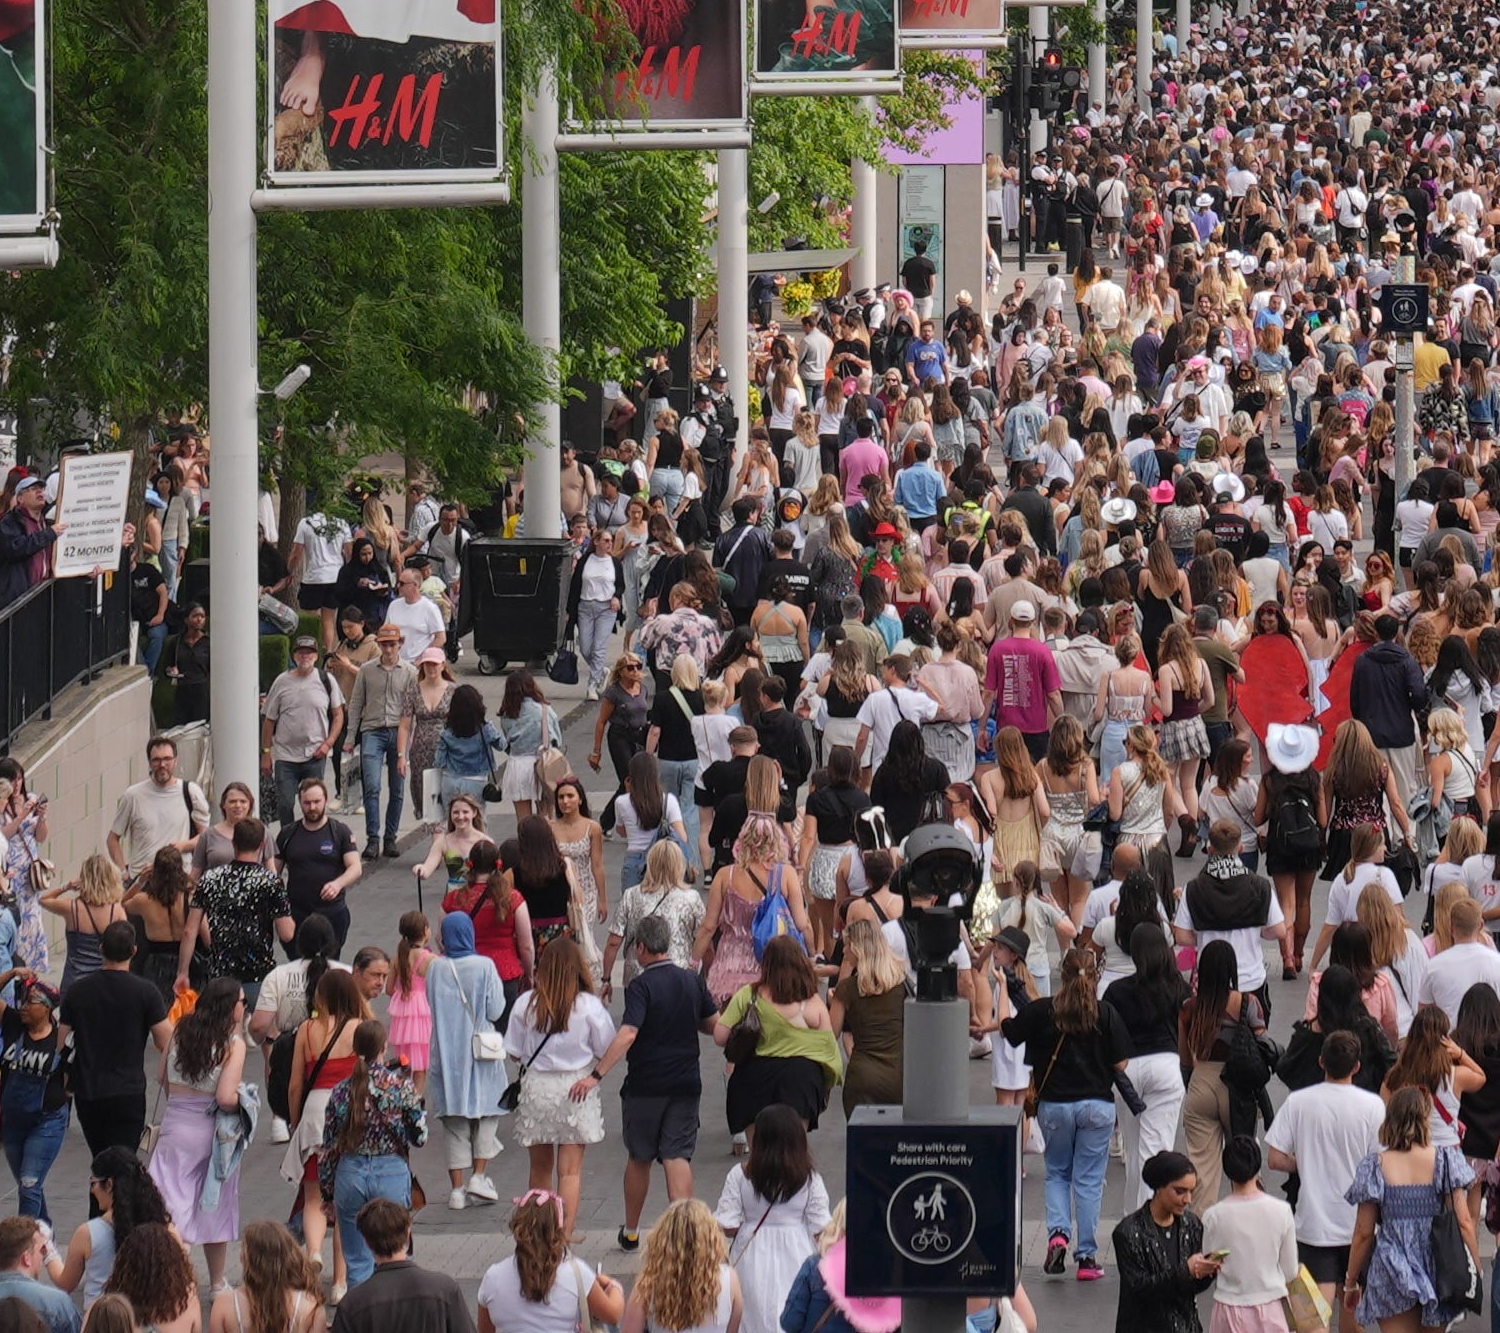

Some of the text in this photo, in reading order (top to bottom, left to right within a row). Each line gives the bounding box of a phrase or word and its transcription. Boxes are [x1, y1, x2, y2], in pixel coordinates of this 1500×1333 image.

[790, 11, 862, 59] H&M
[327, 72, 442, 150] H&M
[63, 544, 114, 558] 42 MONTHS
[1481, 883, 1497, 897] 13
[897, 1142, 966, 1153] Share with care
[890, 1154, 973, 1167] Pedestrian Priority
